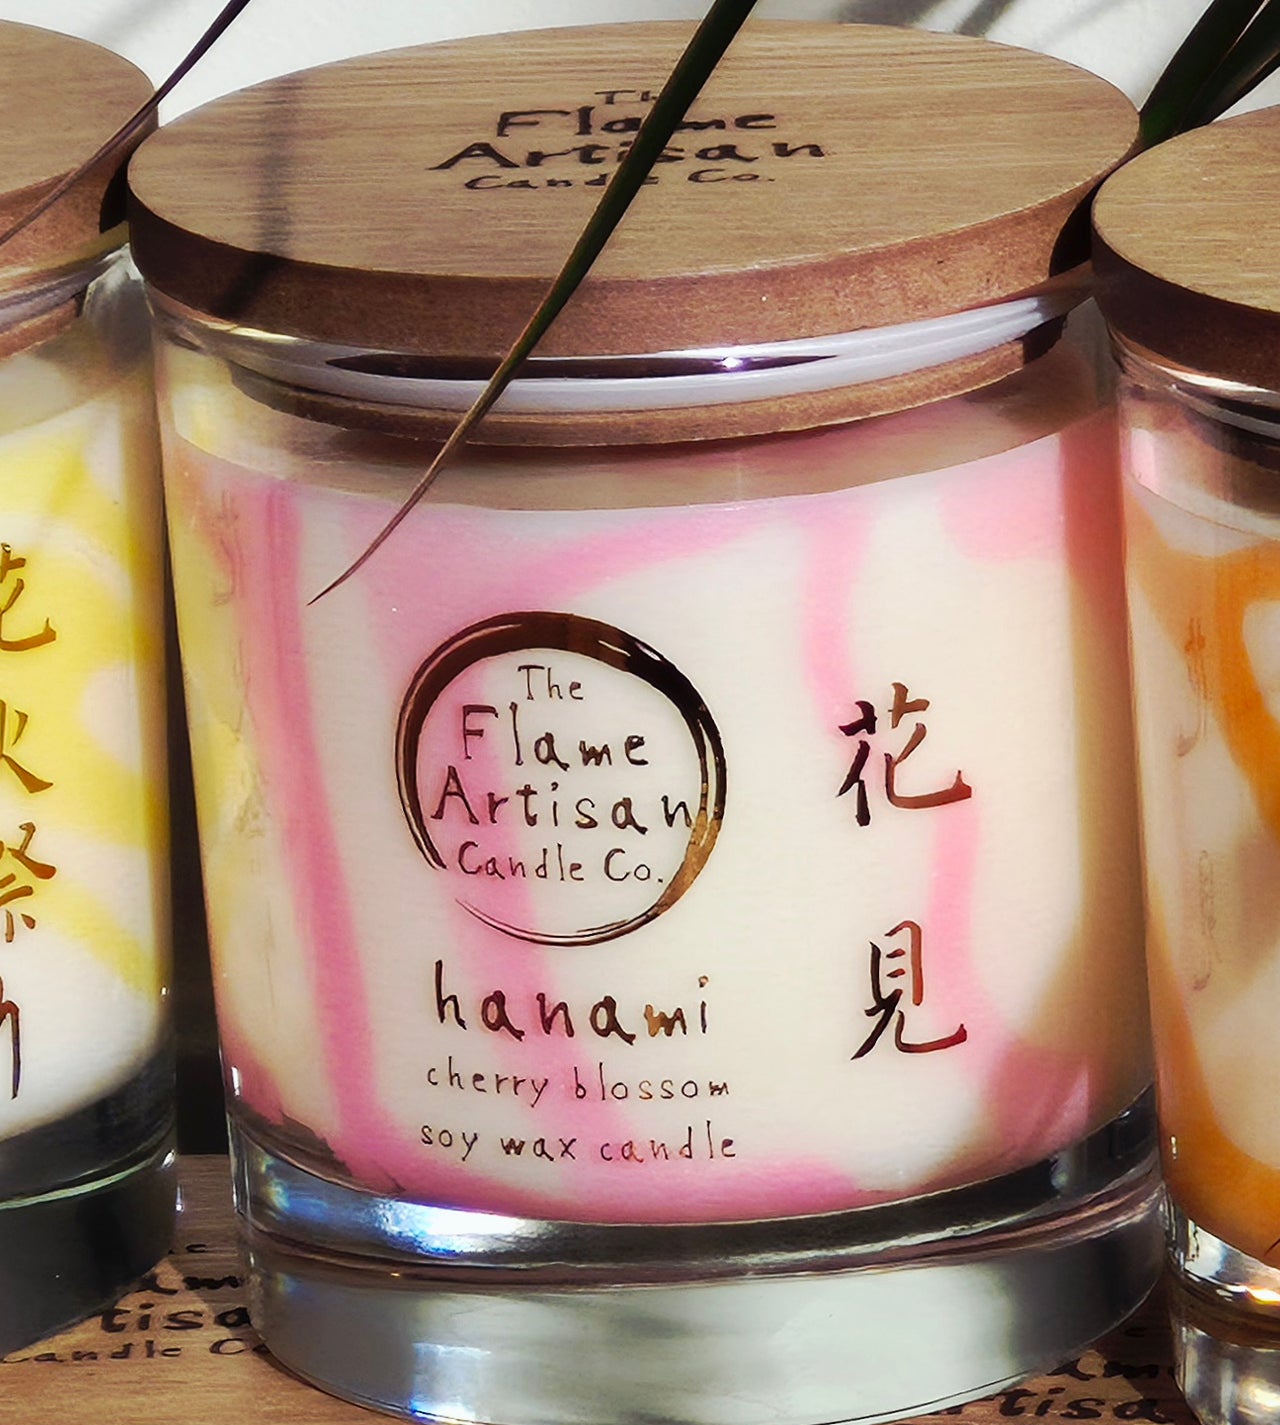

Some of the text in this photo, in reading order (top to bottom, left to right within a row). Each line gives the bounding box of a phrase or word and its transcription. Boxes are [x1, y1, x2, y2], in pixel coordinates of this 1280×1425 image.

[495, 105, 777, 138] Flame
[463, 167, 776, 190] Cande Co.
[517, 664, 584, 703] The
[460, 701, 650, 772] Flame
[430, 764, 694, 836] Artisan
[457, 840, 665, 884] Candle Co.
[834, 681, 975, 1062] 花見
[431, 958, 711, 1046] hanami
[426, 1055, 731, 1109] cherry blossom
[419, 1120, 739, 1164] soy wax candle
[99, 1302, 252, 1334] tisa
[926, 1386, 1176, 1425] tisa
